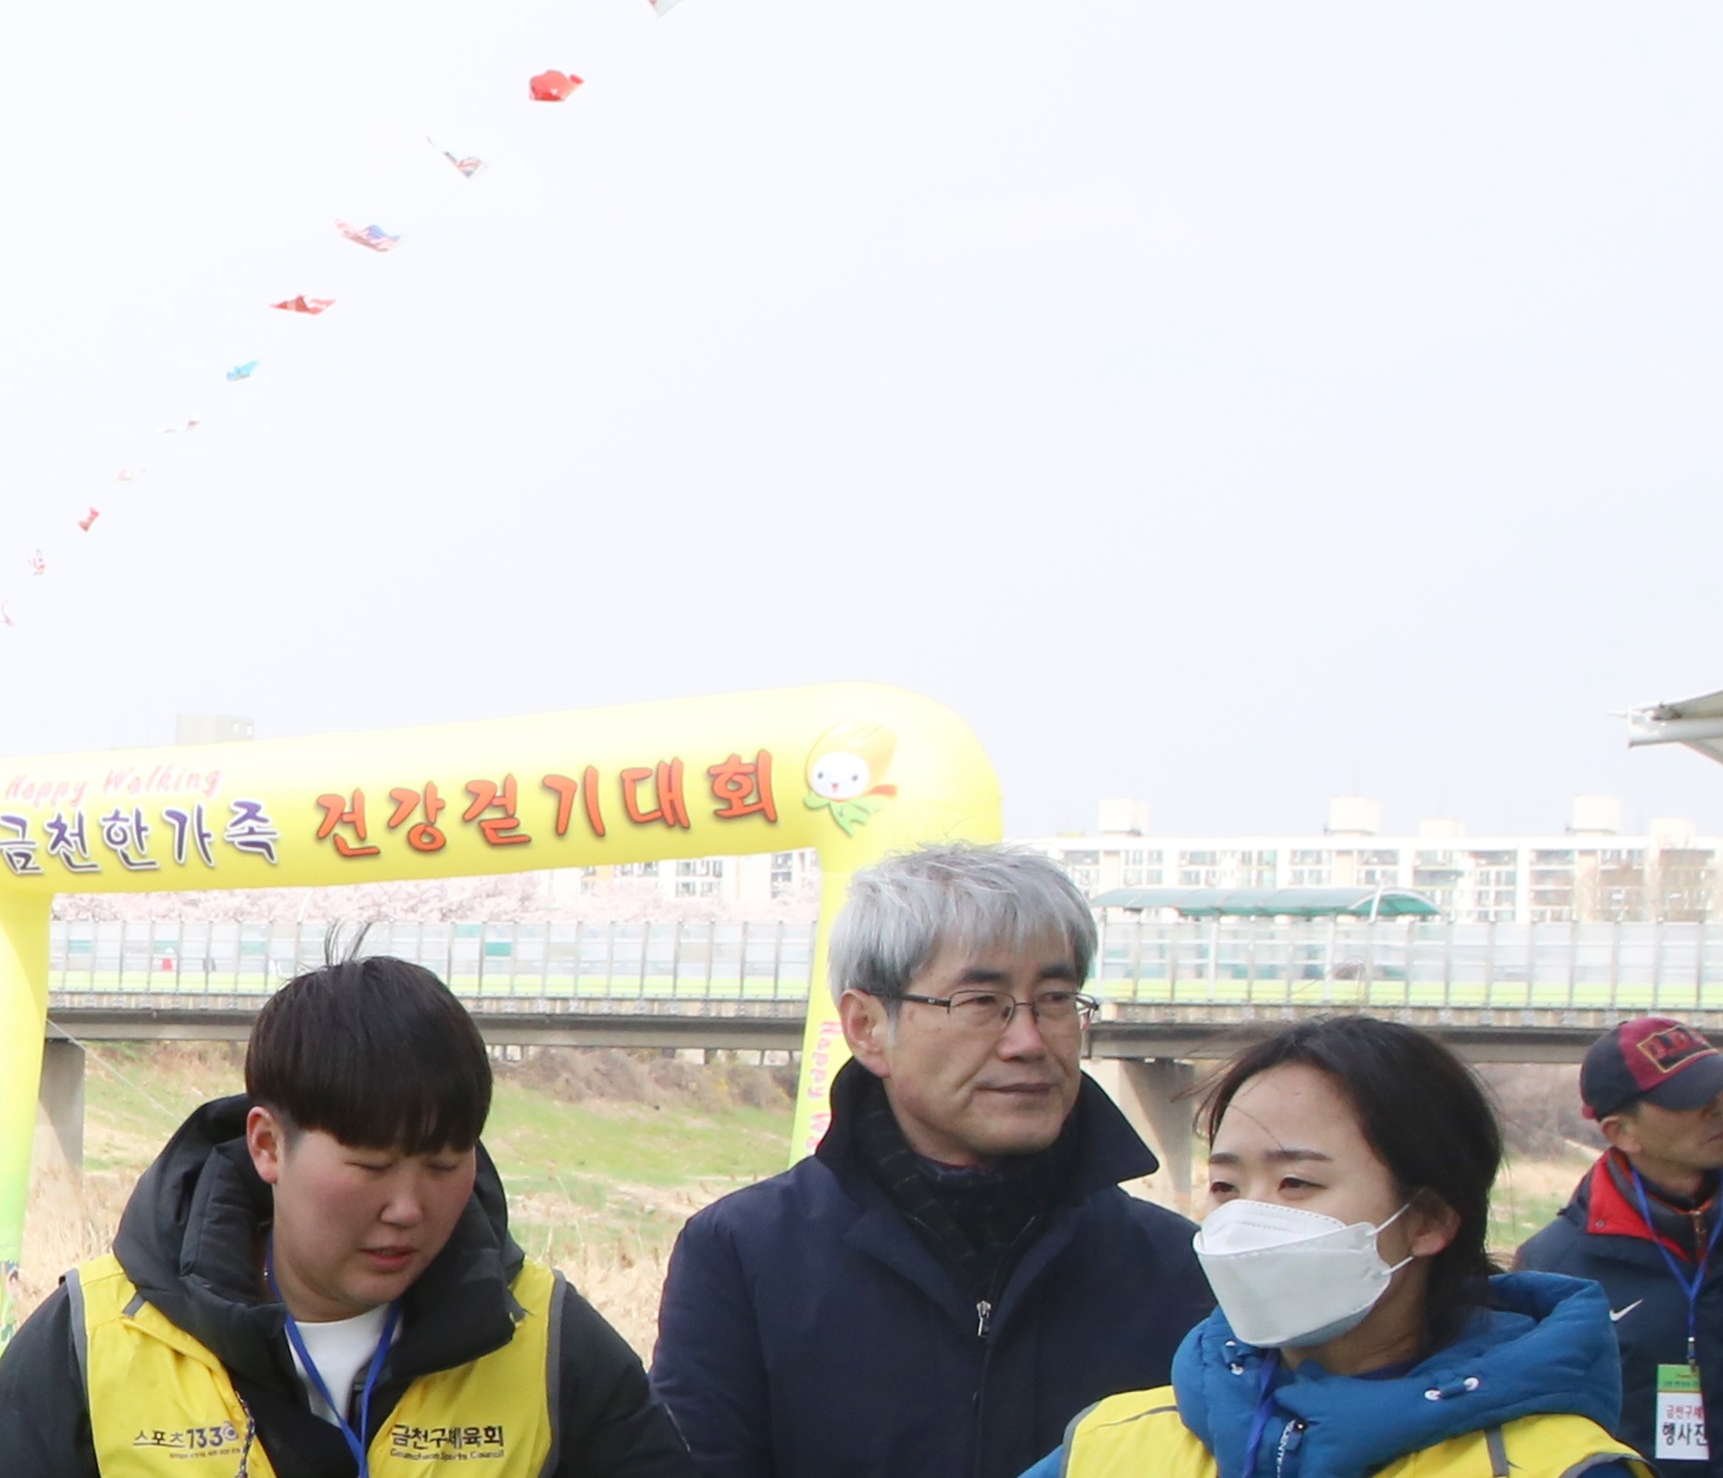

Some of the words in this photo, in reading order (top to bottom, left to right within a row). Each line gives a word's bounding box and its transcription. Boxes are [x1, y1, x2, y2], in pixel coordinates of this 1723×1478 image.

[4, 774, 88, 809] Happy
[103, 764, 223, 798] Walking
[314, 748, 779, 859] 건강걷기대회
[391, 1424, 504, 1450] 금천구체육회
